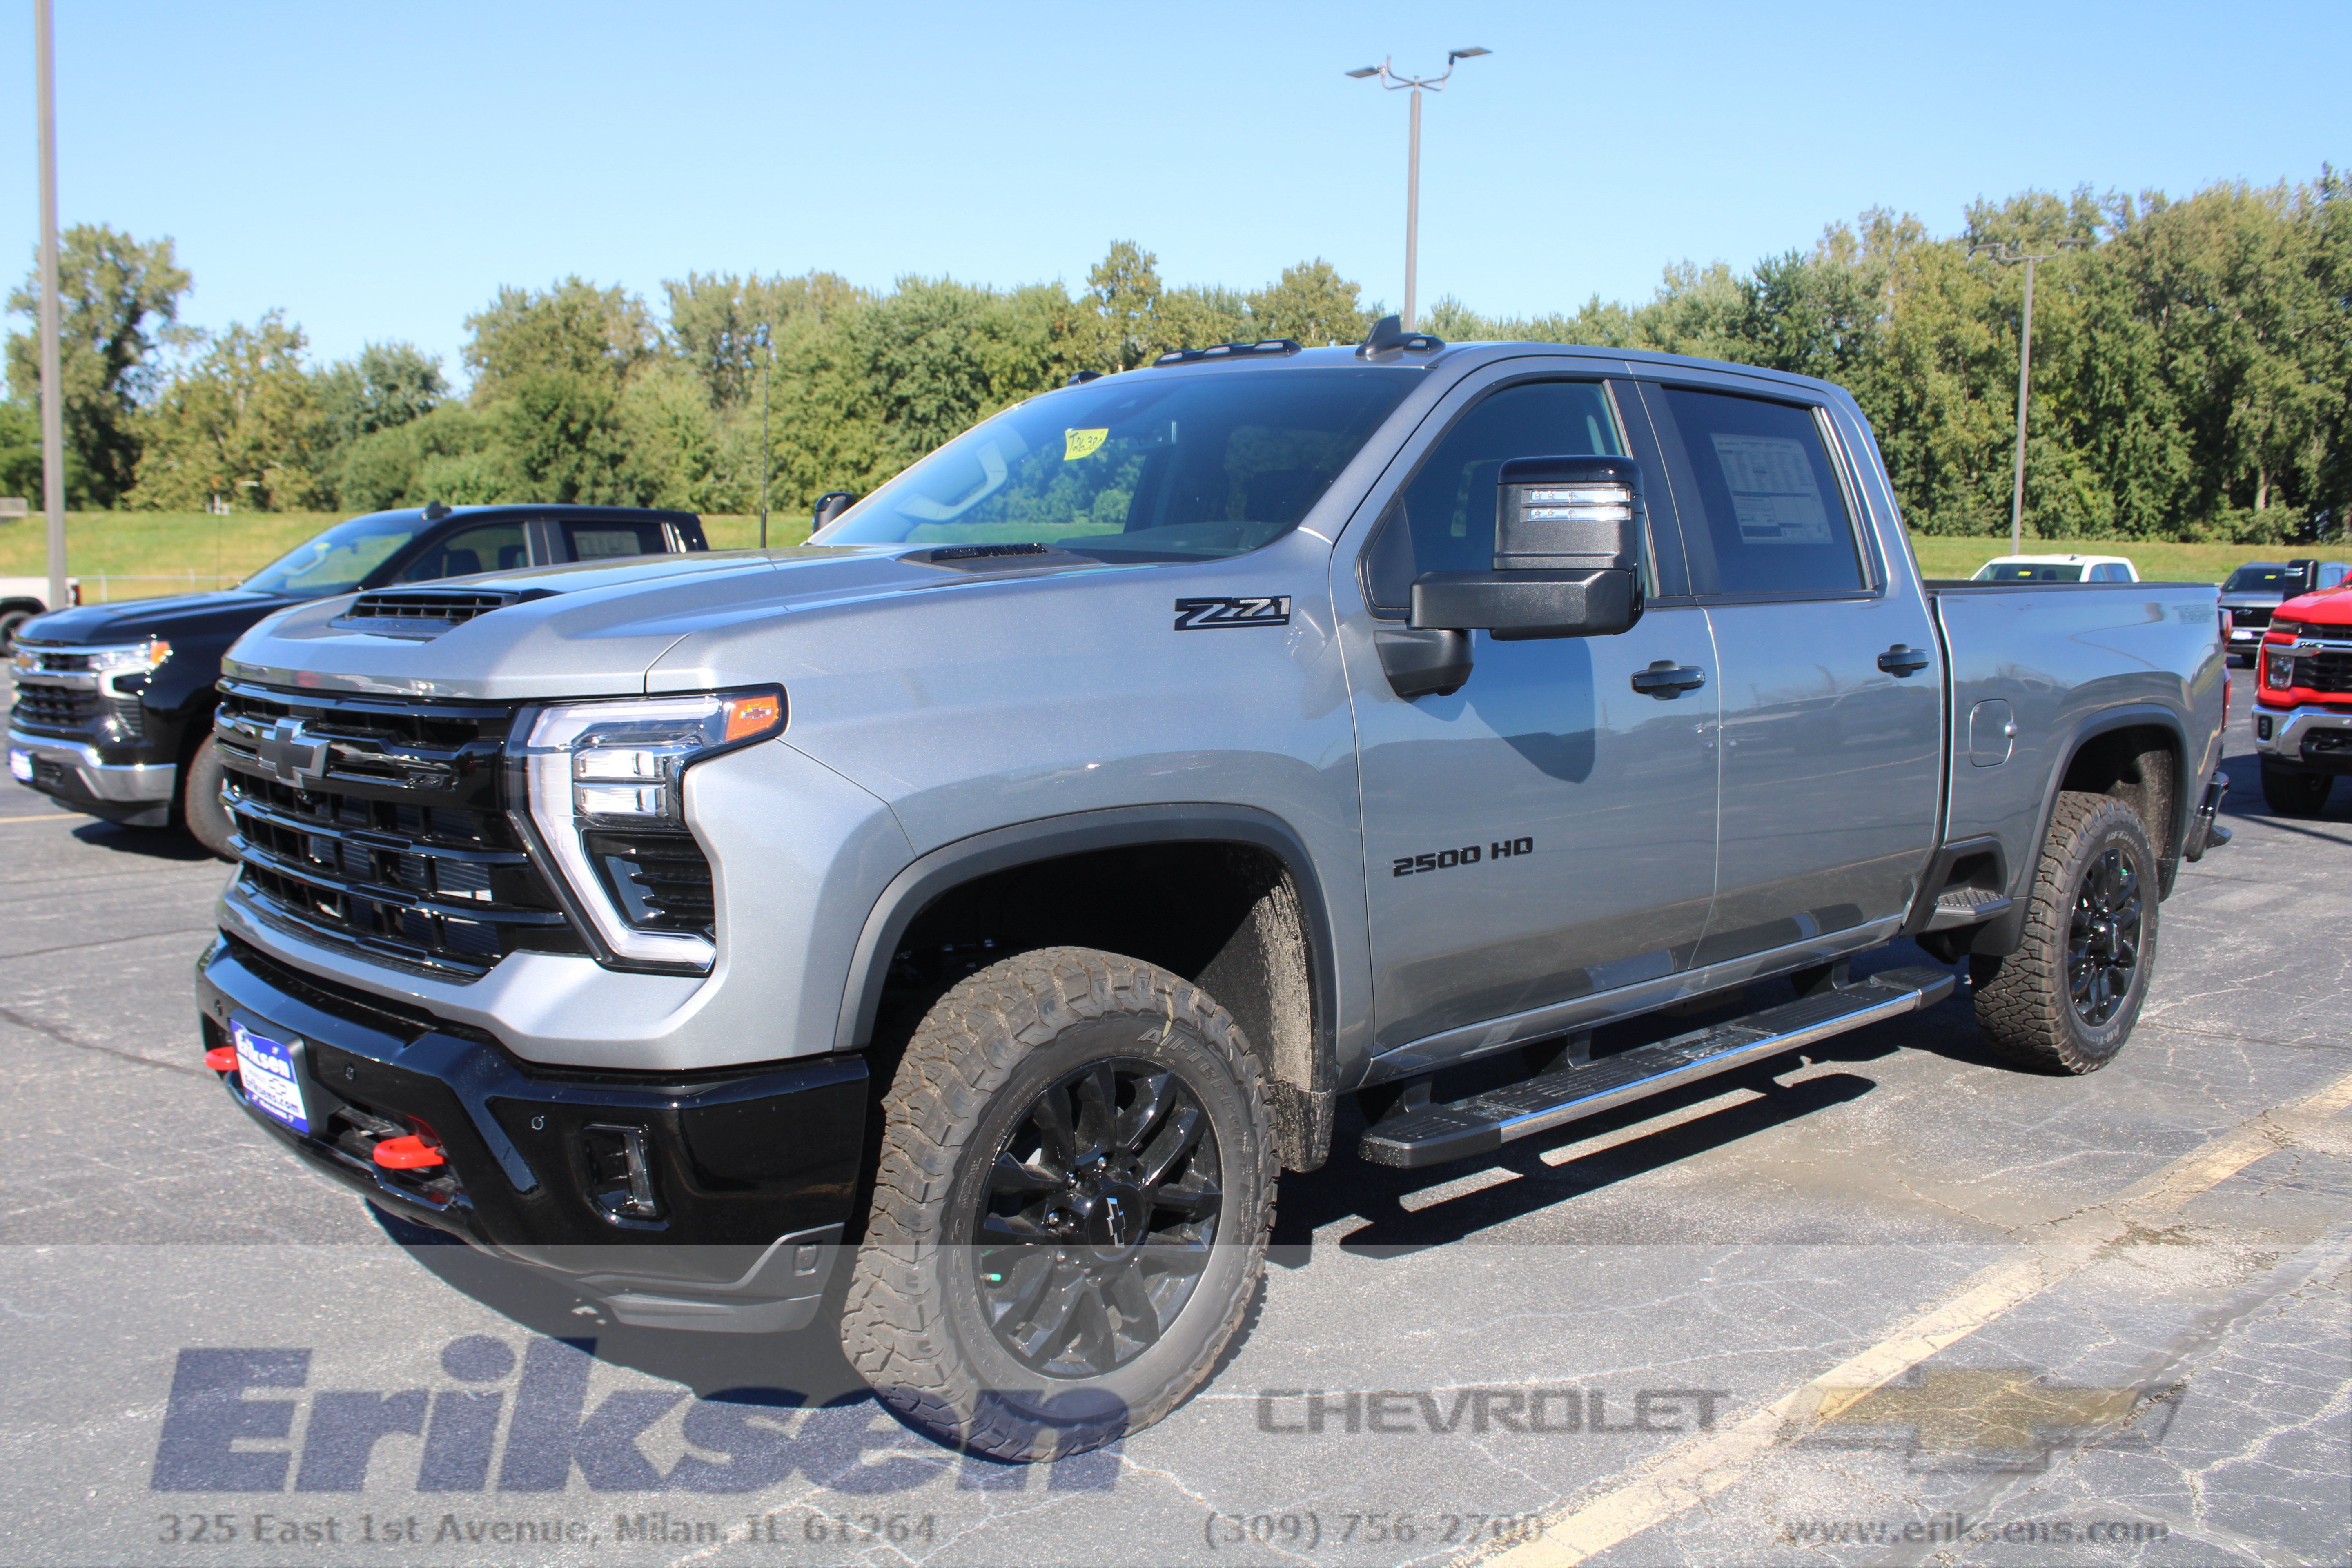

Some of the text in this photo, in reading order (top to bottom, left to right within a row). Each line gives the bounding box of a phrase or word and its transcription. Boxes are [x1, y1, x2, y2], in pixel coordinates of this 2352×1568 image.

[1174, 595, 1291, 631] Z71
[1393, 837, 1533, 877] 2500 HD
[234, 1029, 291, 1078] Eriksen
